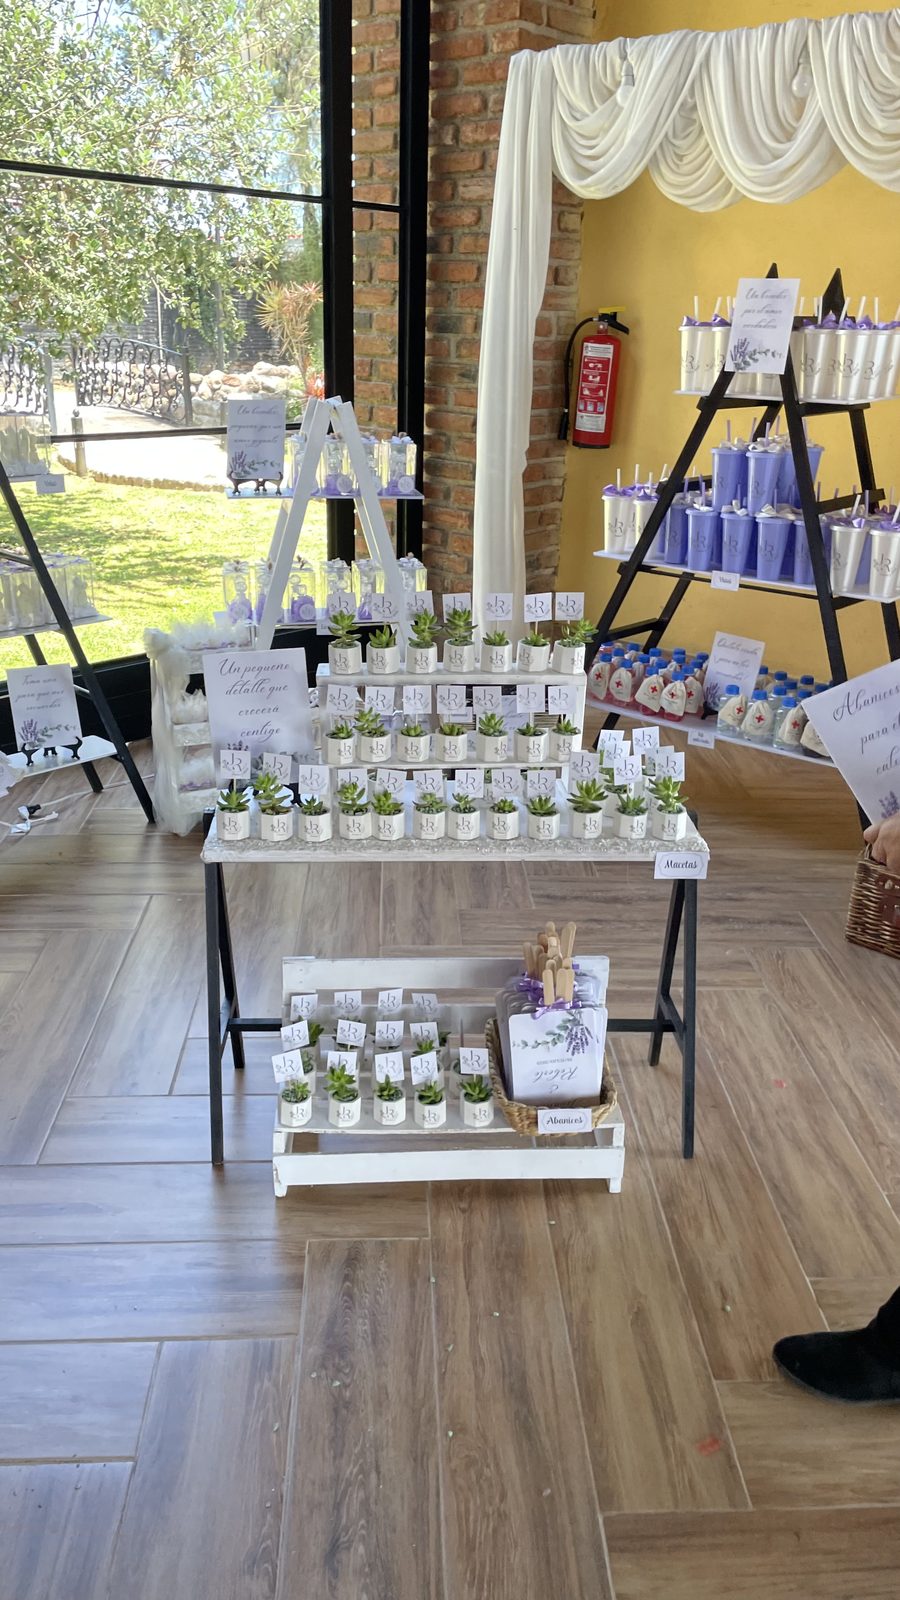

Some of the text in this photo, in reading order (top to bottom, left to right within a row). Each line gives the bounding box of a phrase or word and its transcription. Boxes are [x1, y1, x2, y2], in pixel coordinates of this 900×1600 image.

[219, 658, 240, 676] Un
[225, 679, 288, 699] detalle que
[240, 721, 280, 743] contigo
[861, 725, 889, 755] para
[664, 859, 697, 869] Macetas
[533, 1066, 578, 1084] Roberto
[546, 1116, 583, 1125] Abanicos
